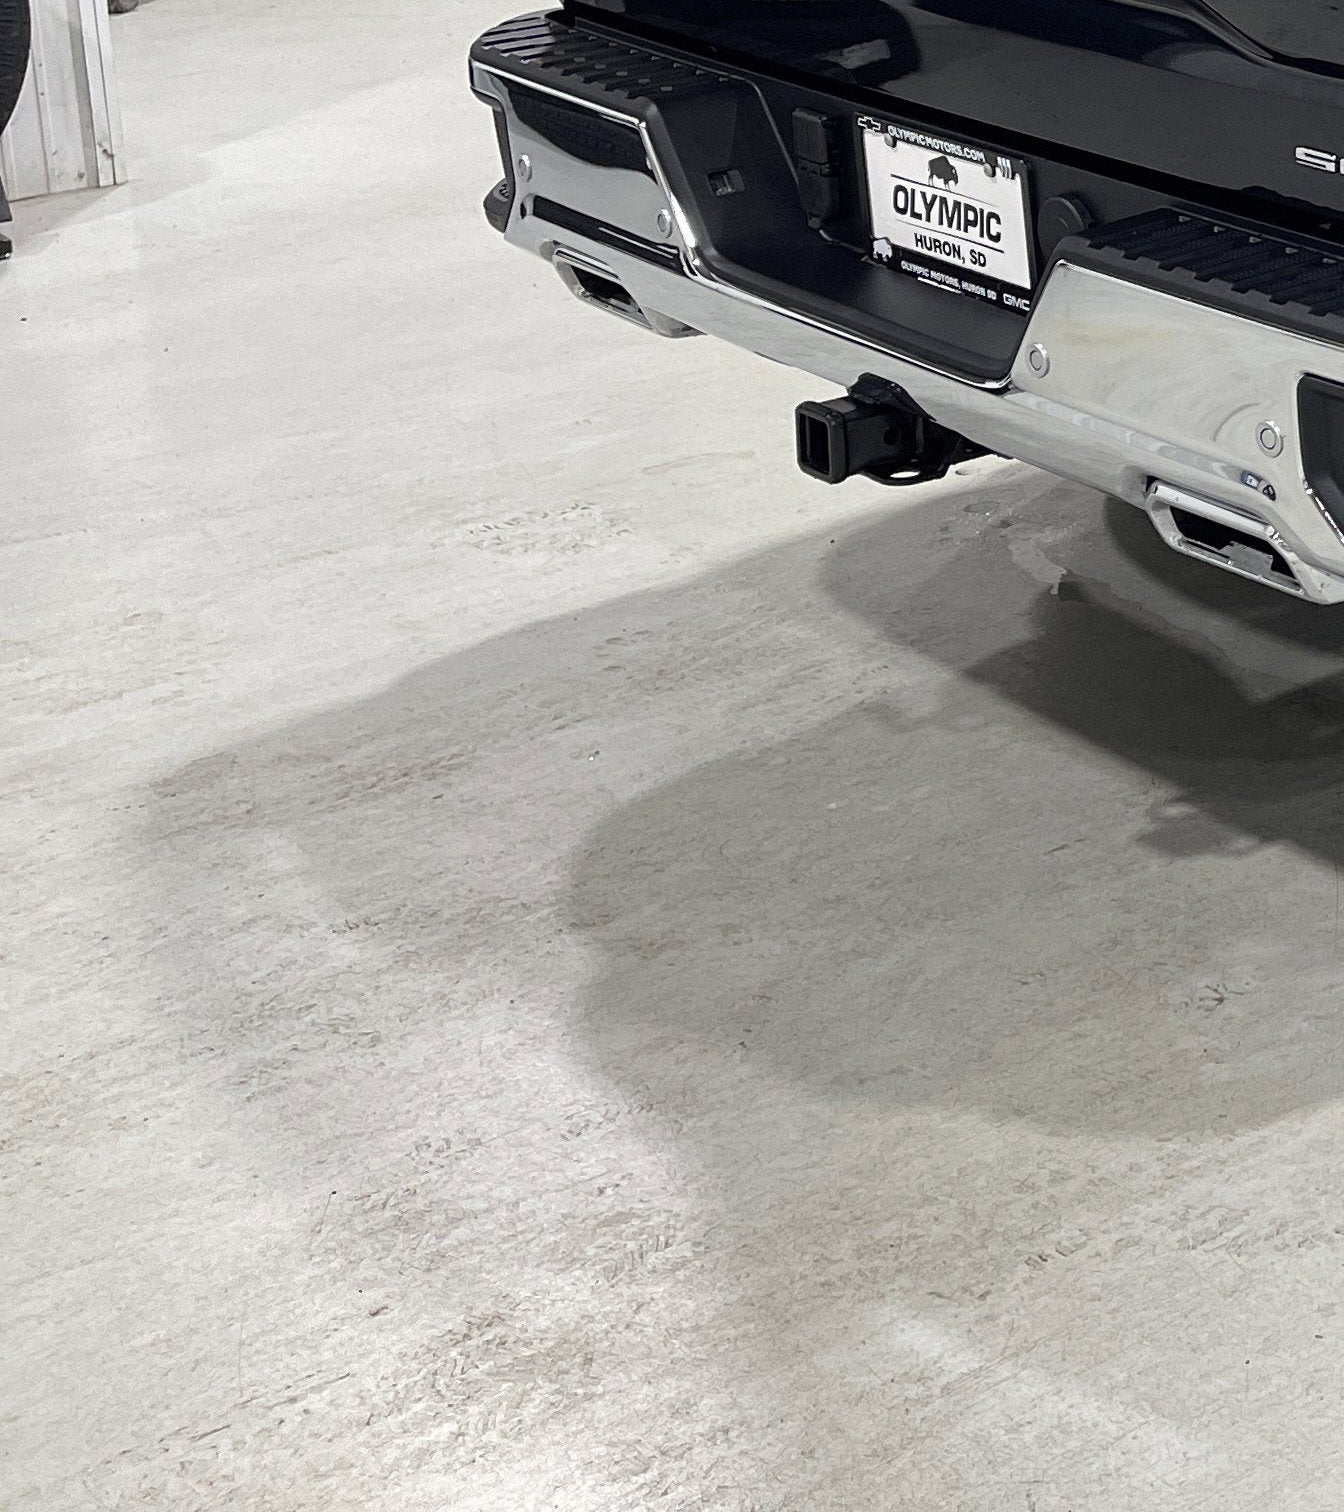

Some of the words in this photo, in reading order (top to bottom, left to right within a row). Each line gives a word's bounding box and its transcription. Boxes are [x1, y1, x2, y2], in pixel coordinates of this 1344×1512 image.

[887, 124, 986, 163] OLYMPICMOTORS.COM
[893, 184, 1002, 243] OLYMPIC
[913, 232, 966, 265] HURON,
[969, 248, 987, 268] SD
[900, 259, 930, 278] OLYMPIC
[961, 280, 986, 298] HURON
[1002, 292, 1031, 312] GMC
